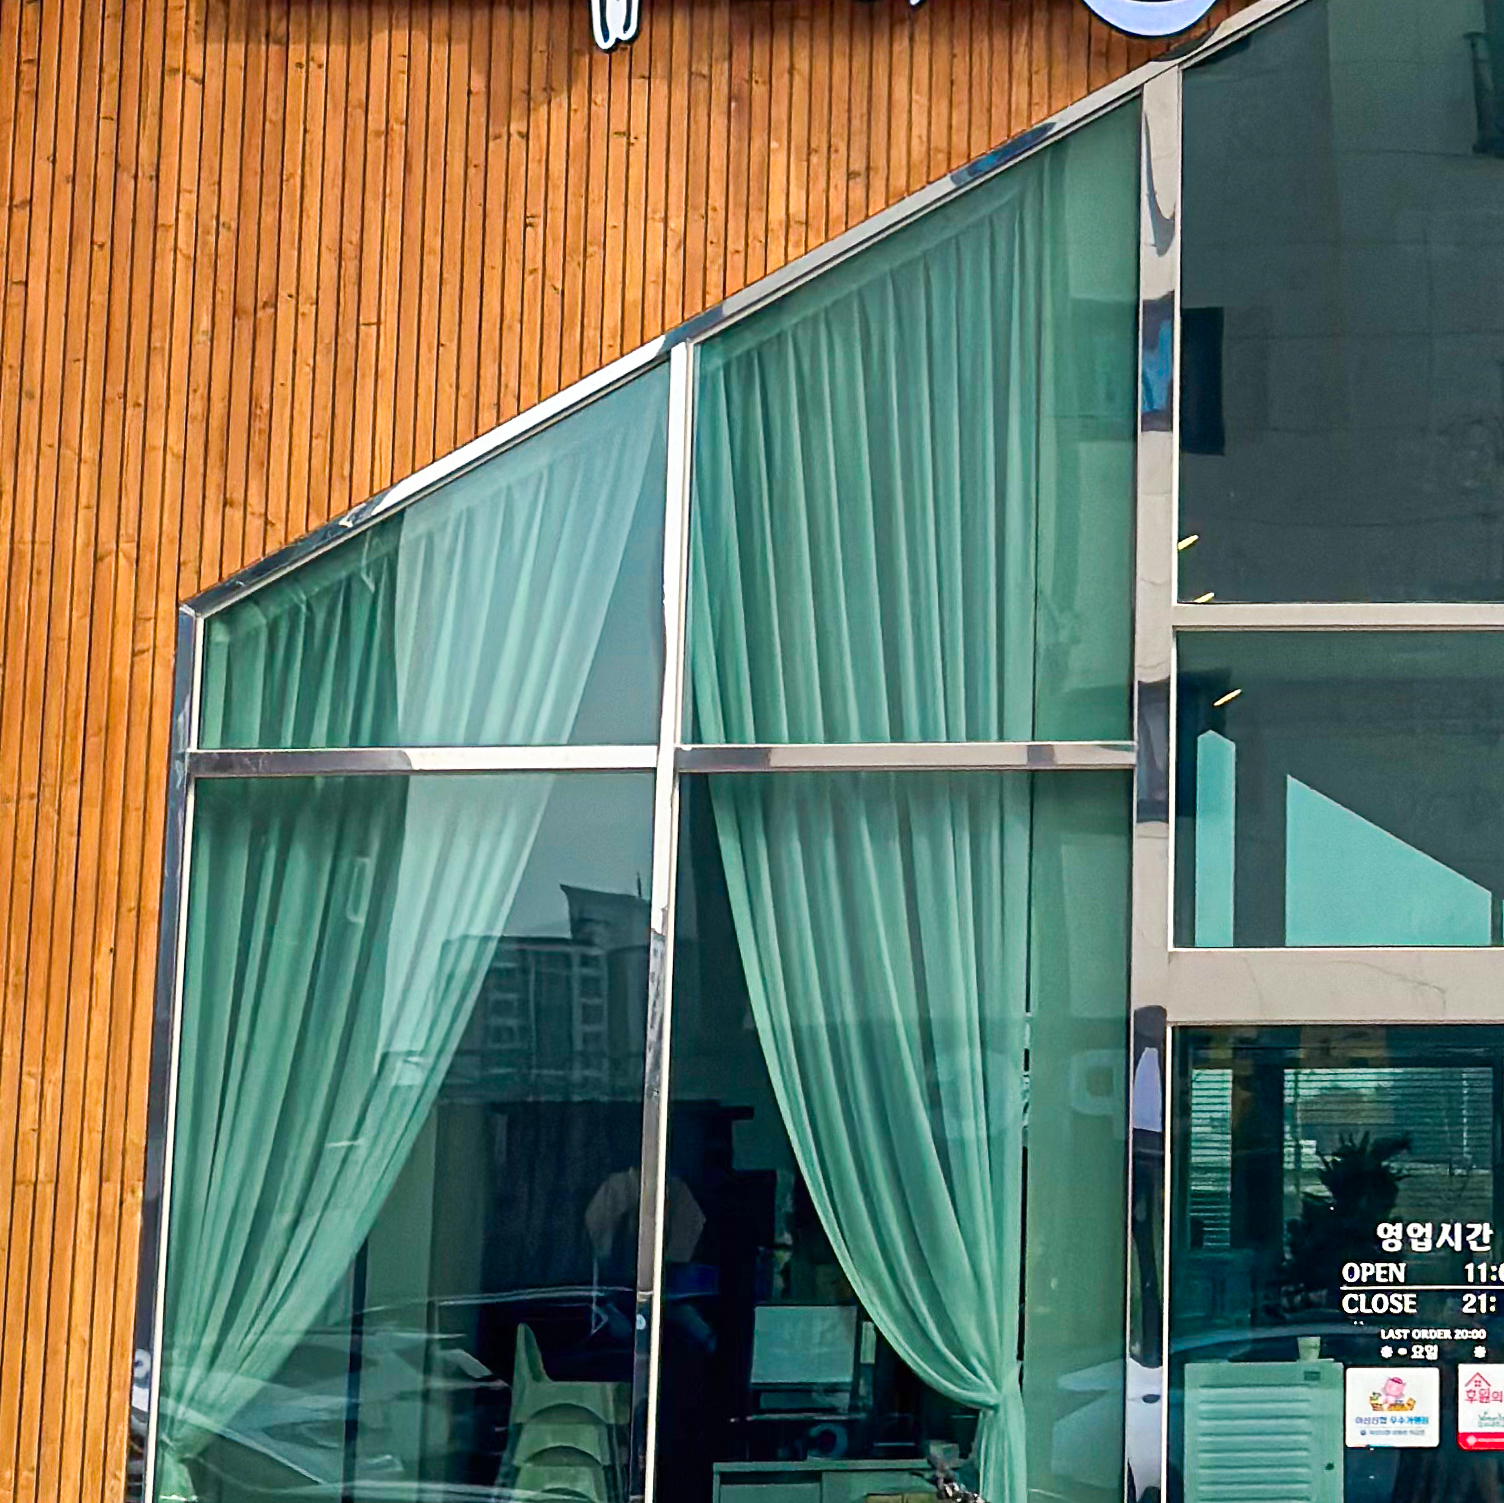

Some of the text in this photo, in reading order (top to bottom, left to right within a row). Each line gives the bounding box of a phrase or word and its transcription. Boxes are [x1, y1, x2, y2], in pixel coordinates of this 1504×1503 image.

[1376, 1222, 1494, 1252] 영업시간
[1341, 1262, 1406, 1283] OPEN
[1341, 1293, 1417, 1314] CLOSE
[1380, 1328, 1487, 1340] LAST ORDER 20:00
